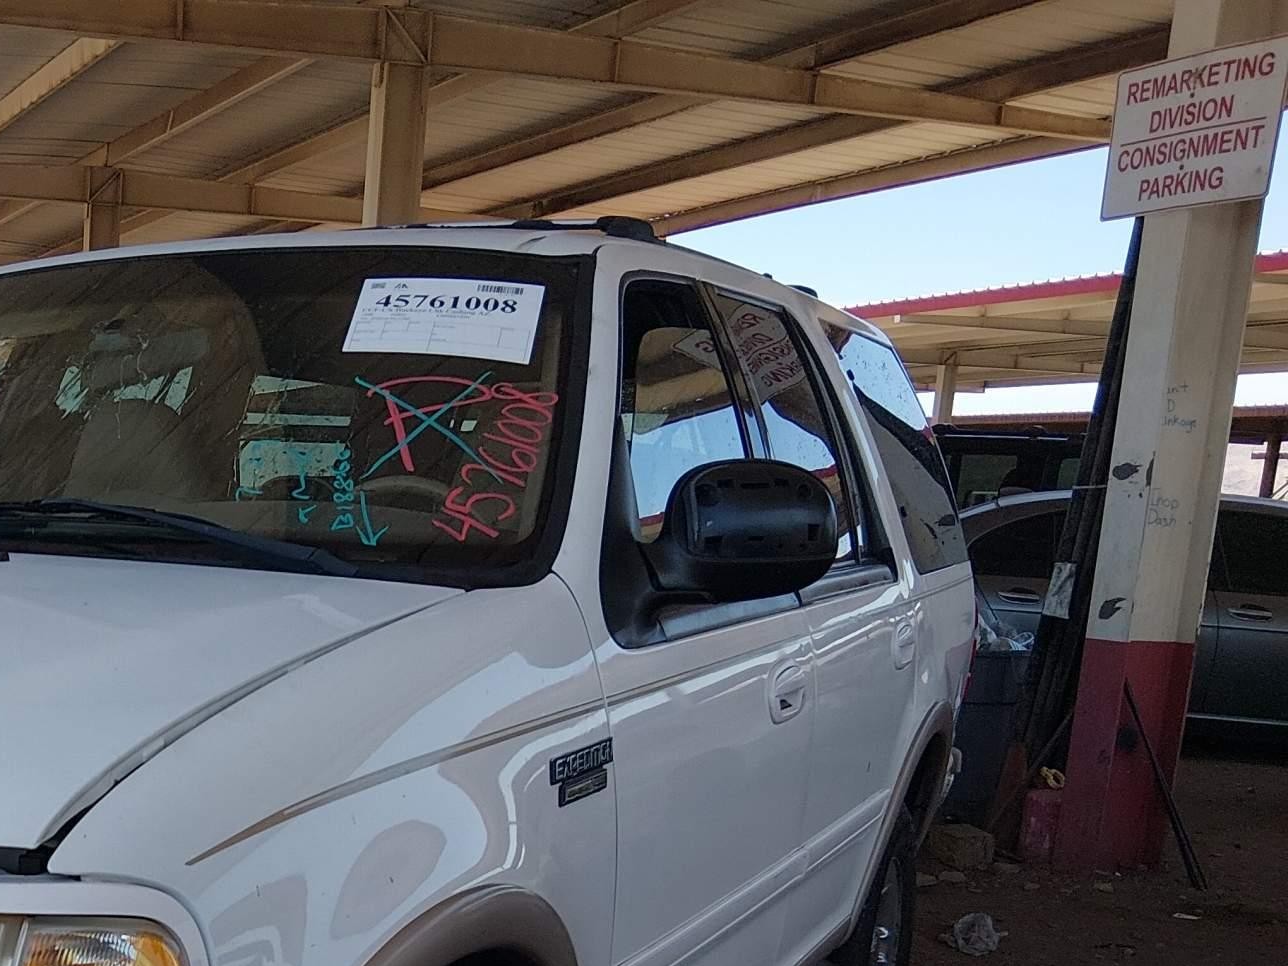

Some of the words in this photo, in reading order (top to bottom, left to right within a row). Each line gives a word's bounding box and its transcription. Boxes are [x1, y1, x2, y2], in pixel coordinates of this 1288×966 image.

[1126, 52, 1276, 106] REMARKETING
[1149, 95, 1235, 133] DIVISION
[1117, 125, 1265, 173] CONSIGNMENT
[1138, 166, 1224, 202] PARKING
[376, 294, 518, 313] 45761008
[432, 382, 559, 541] 45761008
